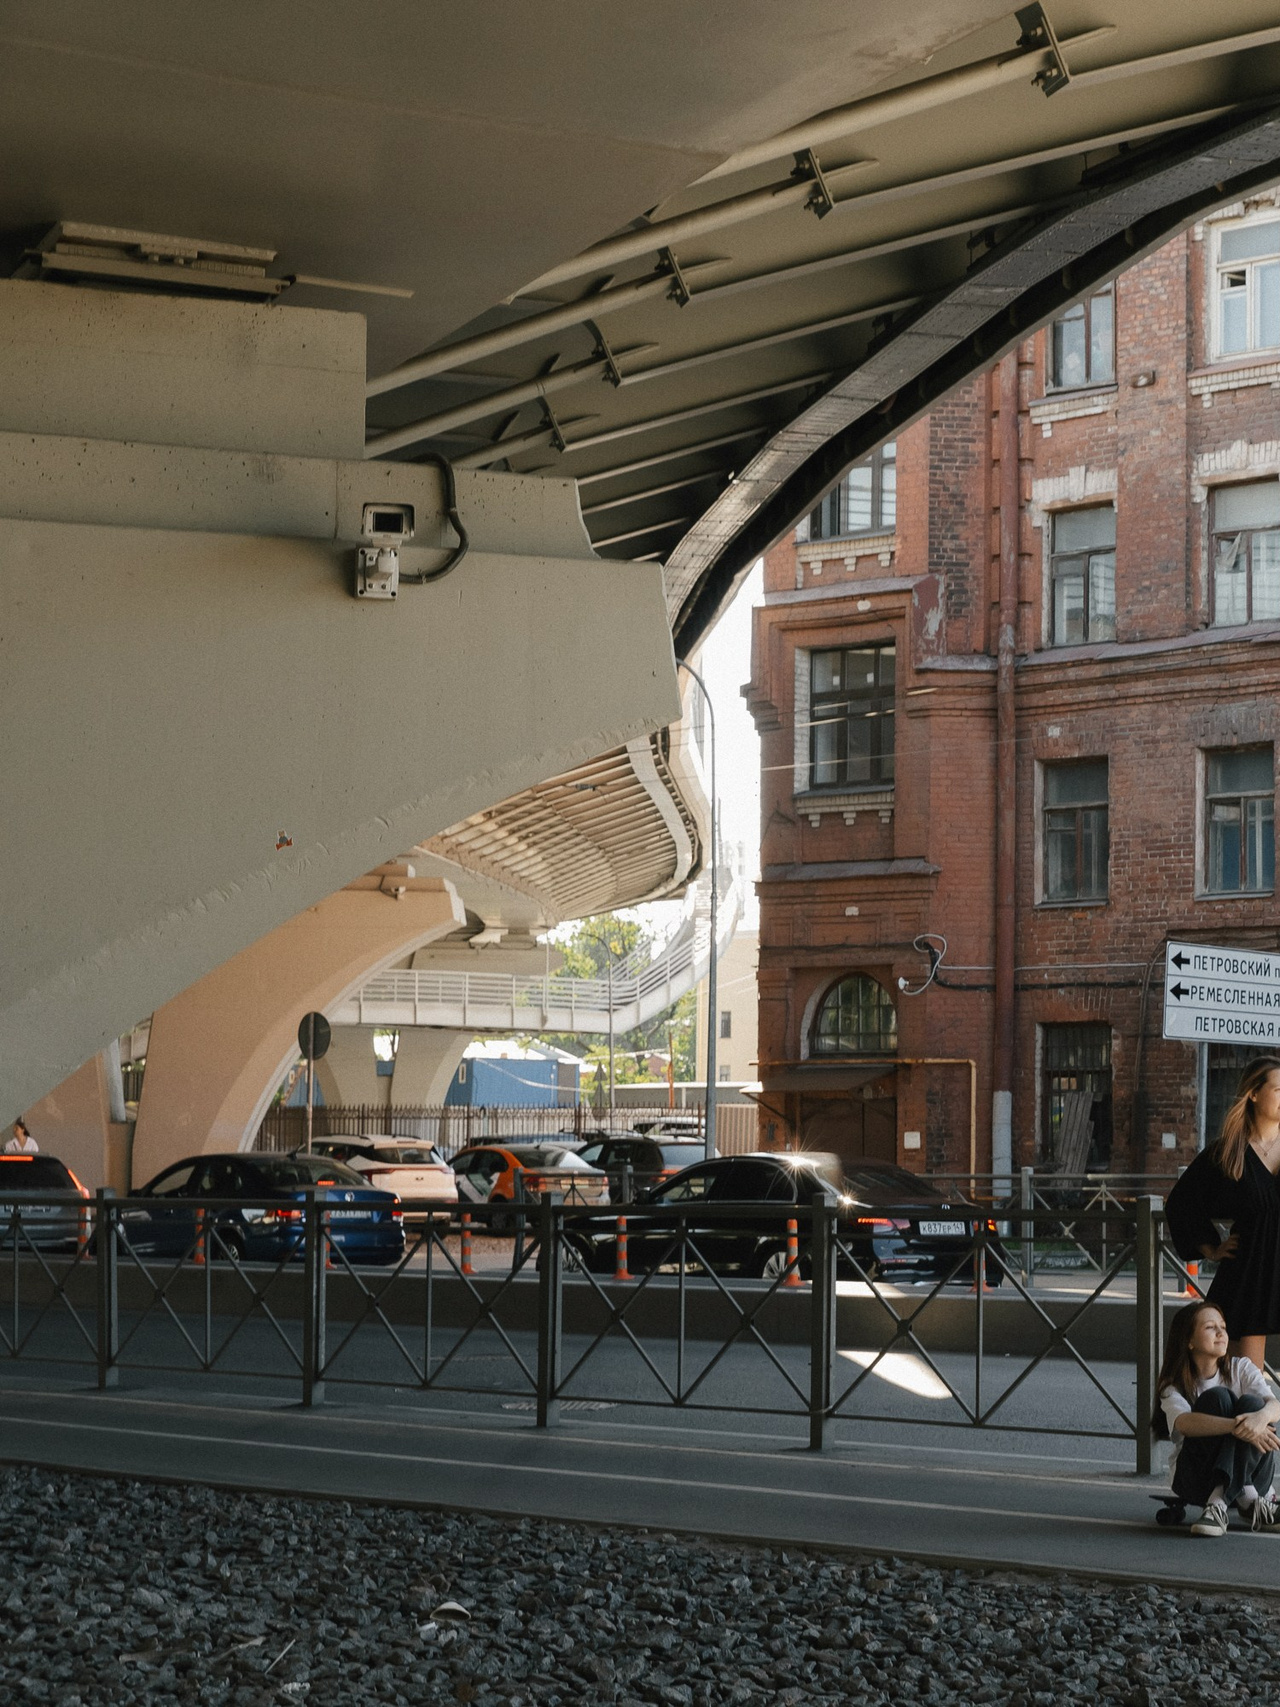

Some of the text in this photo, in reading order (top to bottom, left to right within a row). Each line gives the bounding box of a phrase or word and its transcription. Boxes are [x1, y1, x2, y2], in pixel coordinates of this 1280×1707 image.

[1193, 954, 1271, 978] ПЕТРОВСКИЙ
[1190, 985, 1280, 1008] РЕМЕСЛЕННАЯ
[1194, 1016, 1274, 1037] ПЕТРОВСКАЯ
